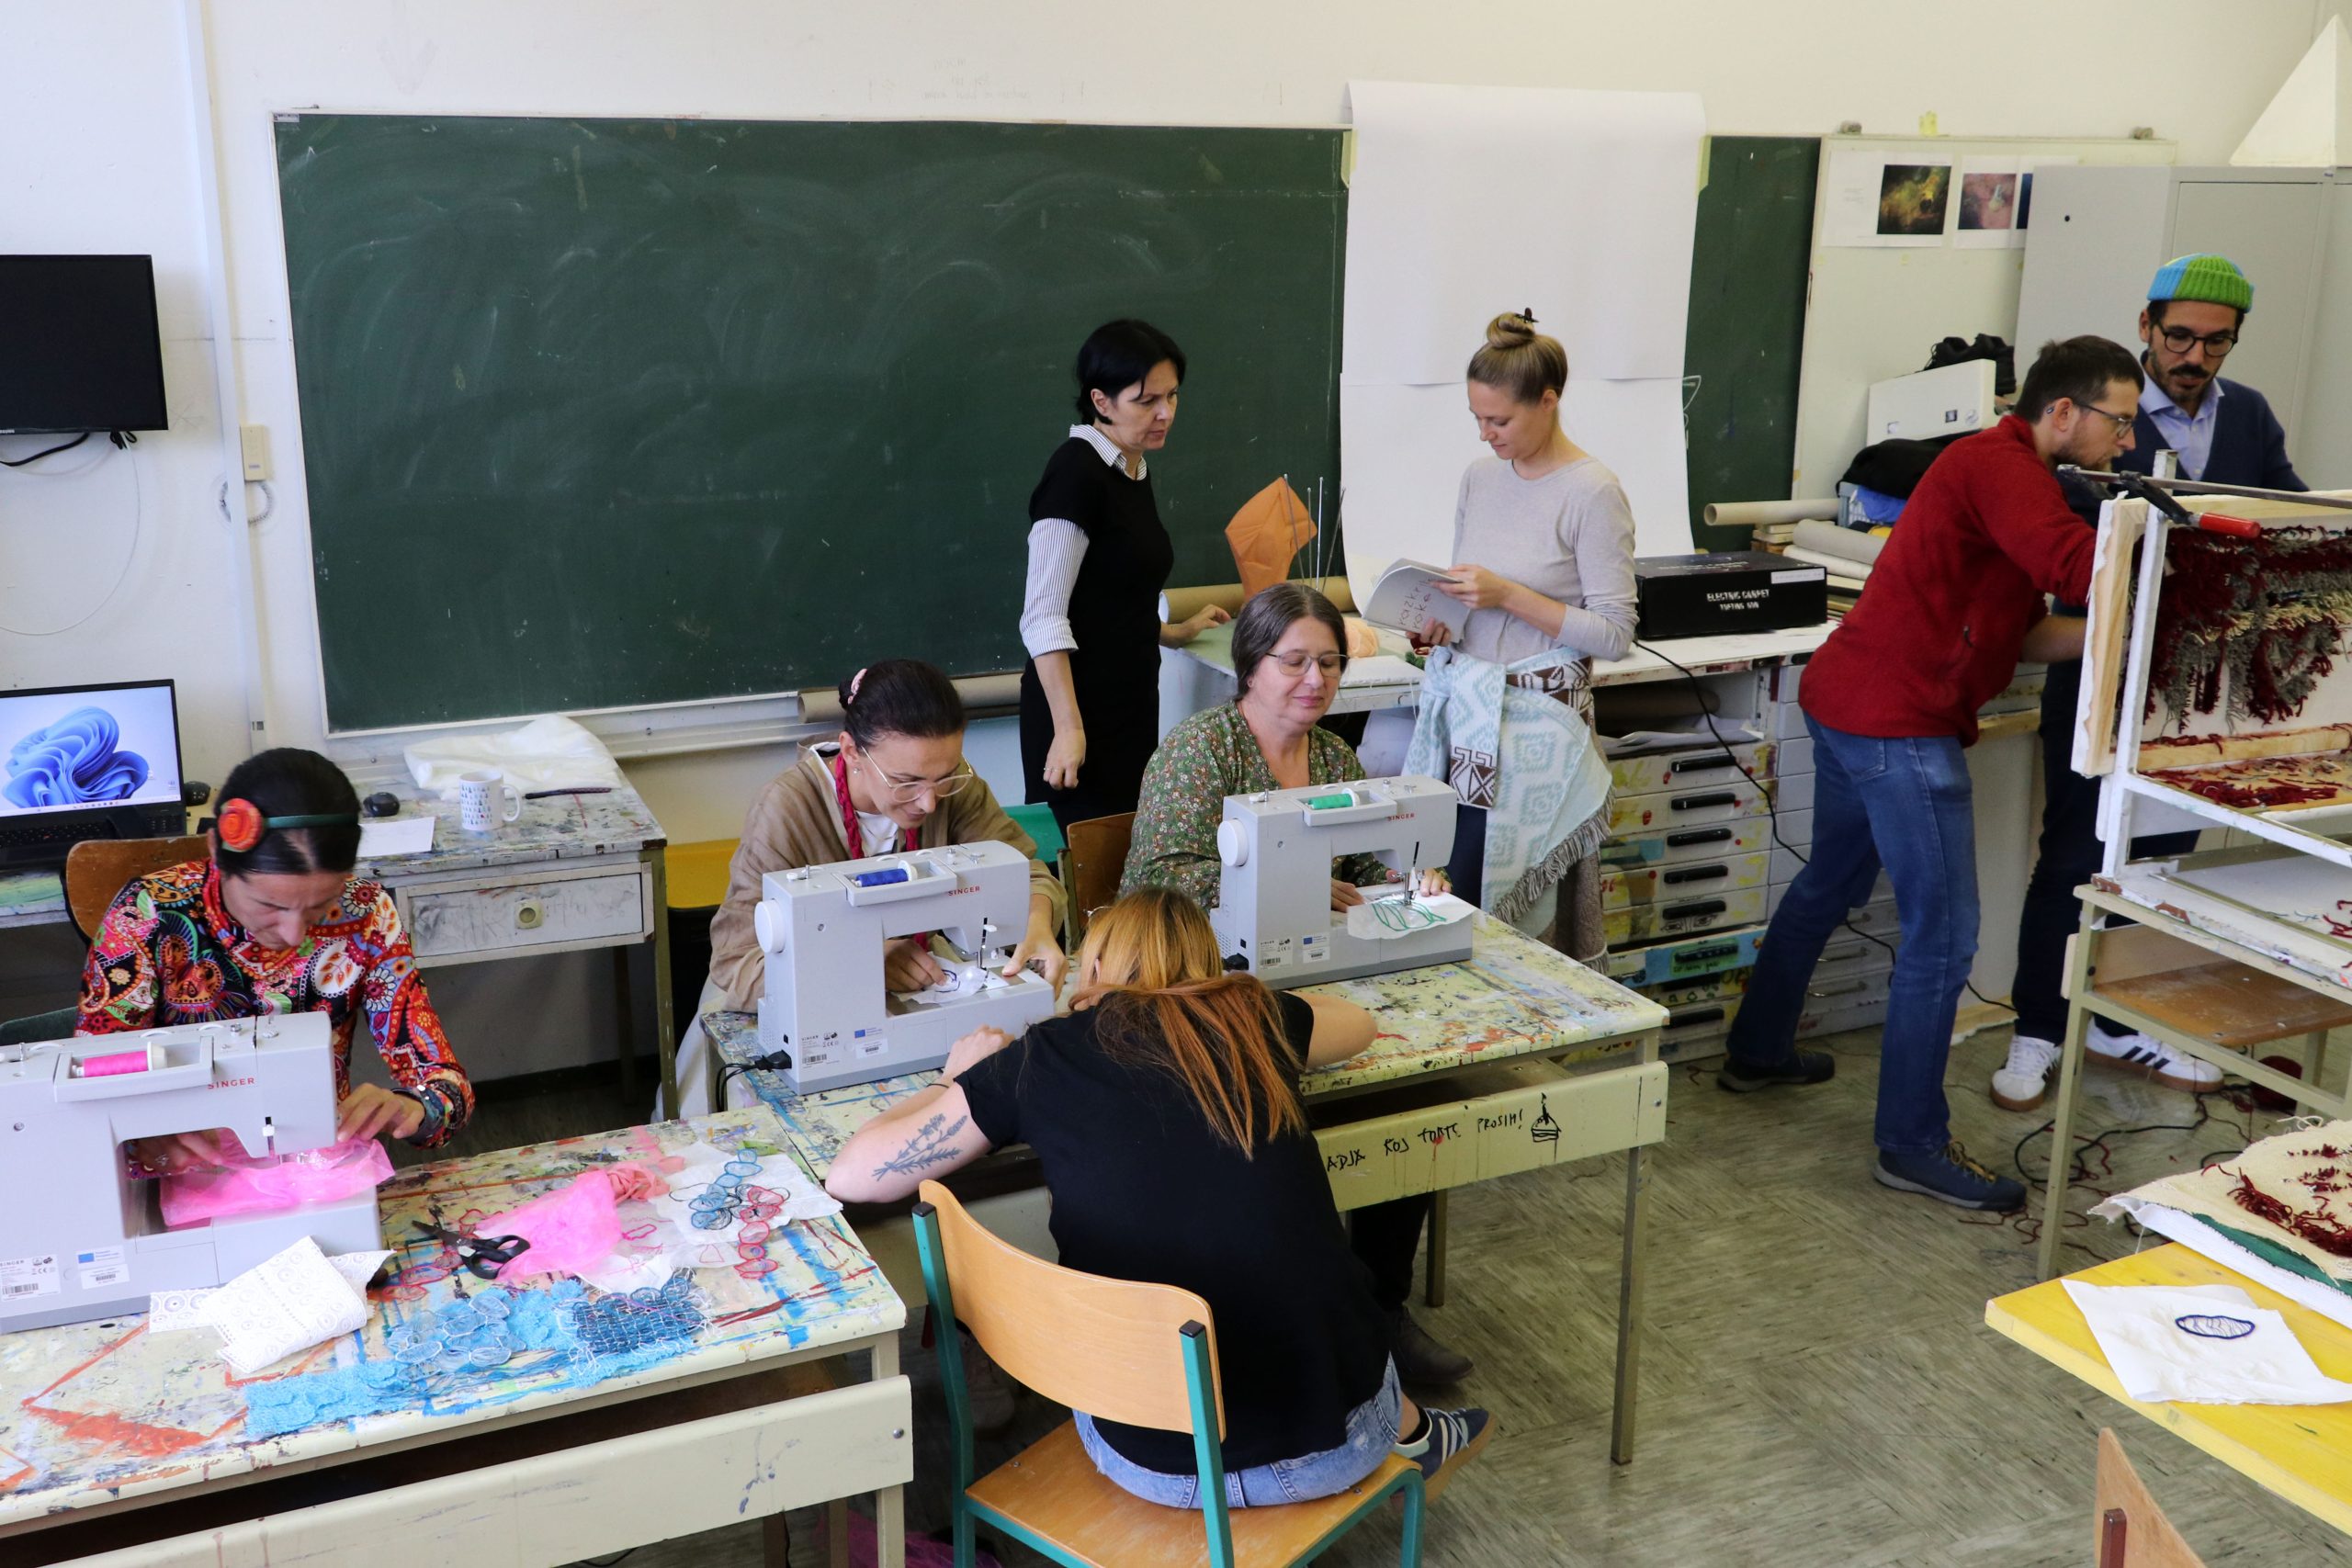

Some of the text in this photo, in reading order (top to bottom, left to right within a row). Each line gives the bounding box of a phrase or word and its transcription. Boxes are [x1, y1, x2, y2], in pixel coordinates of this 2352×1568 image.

[1387, 813, 1415, 821] SINGER
[948, 886, 980, 896] SINGER
[207, 1077, 254, 1089] SINGER
